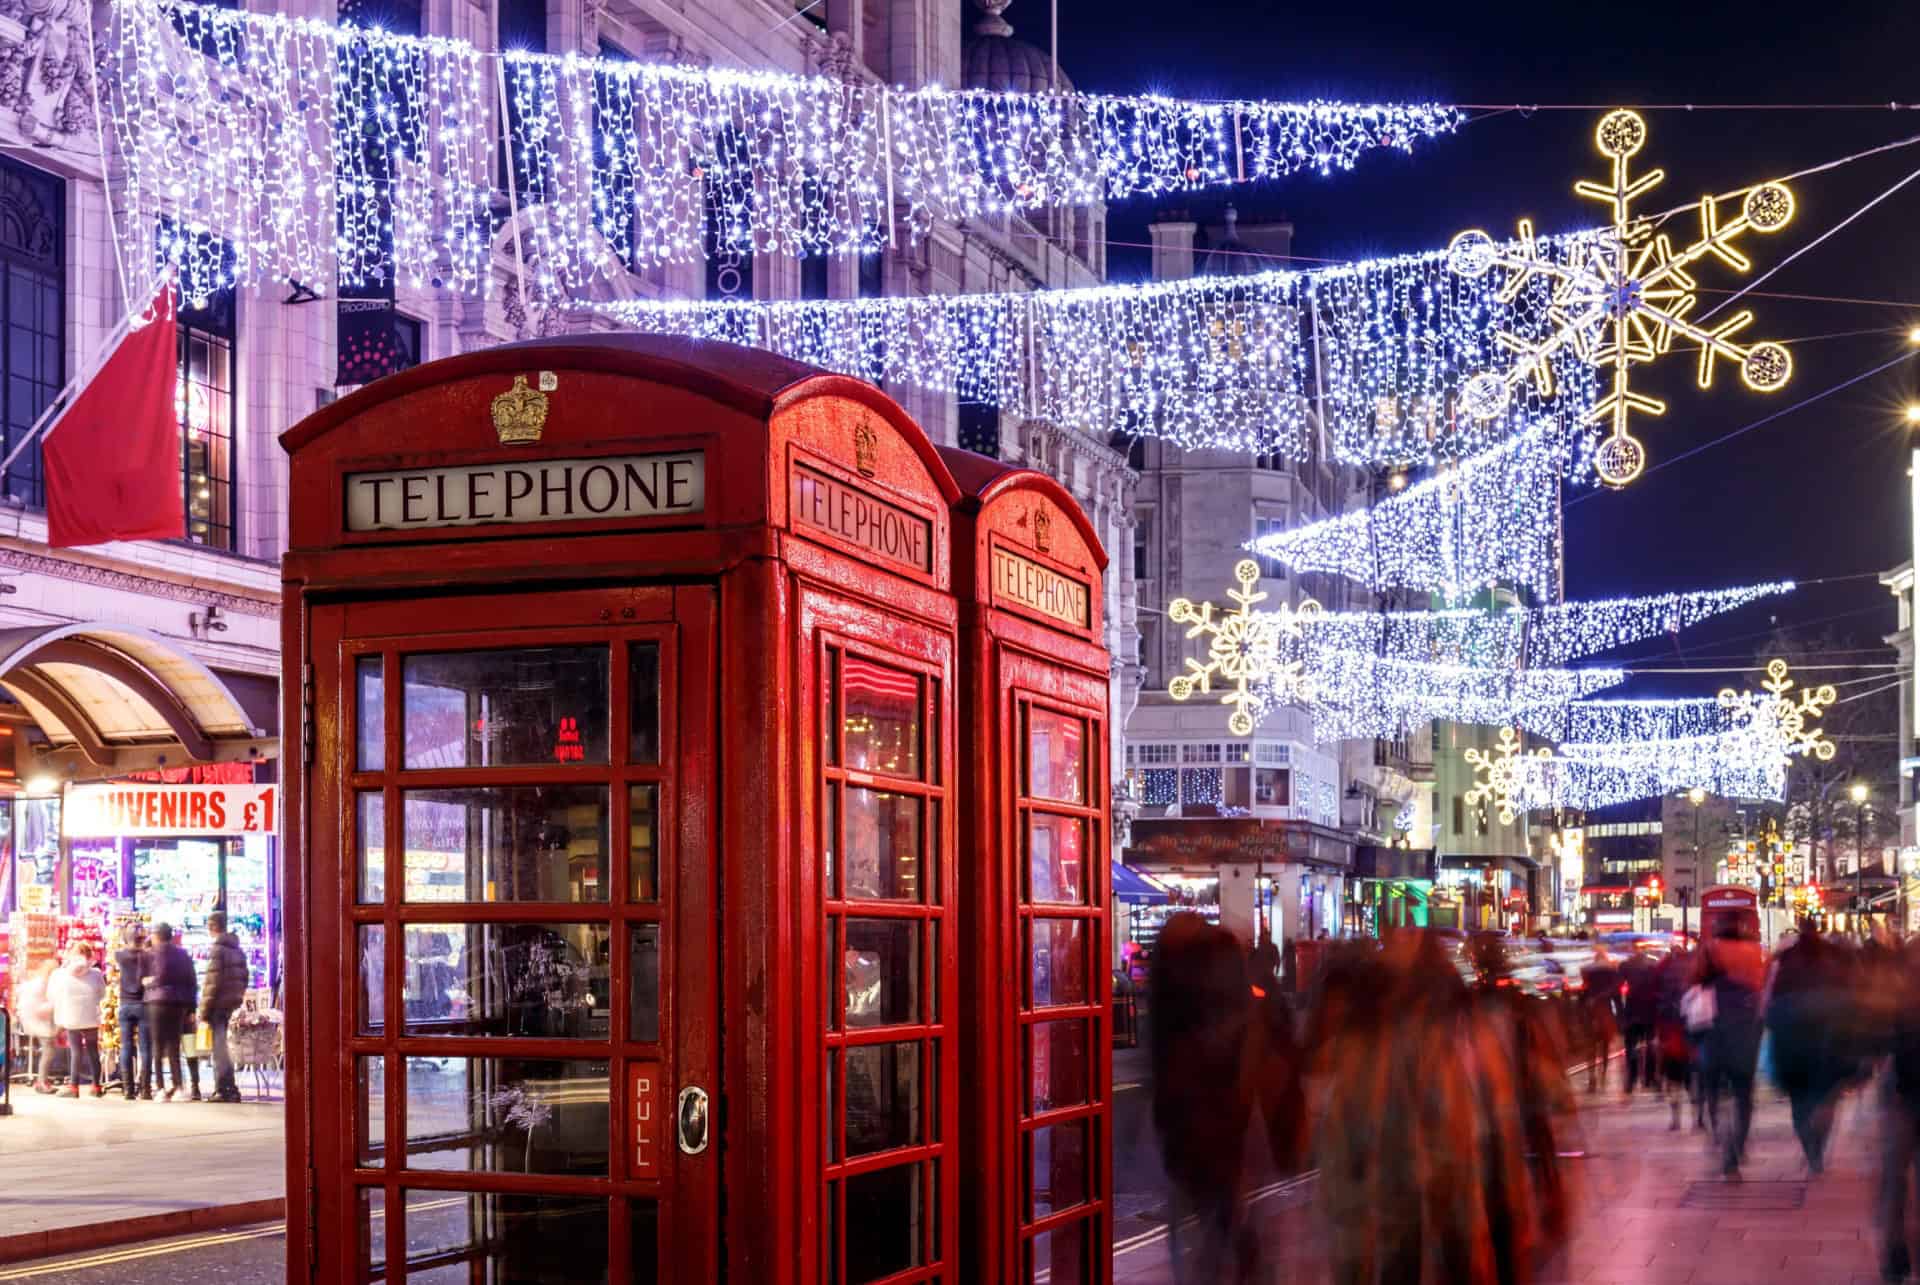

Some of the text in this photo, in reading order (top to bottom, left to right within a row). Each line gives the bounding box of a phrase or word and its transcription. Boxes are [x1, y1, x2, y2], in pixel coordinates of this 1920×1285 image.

[359, 459, 693, 524] TELEPHONE
[795, 473, 922, 566] TELEPHONE
[994, 552, 1084, 624] TELEPHONE
[97, 787, 274, 832] UVENIRS £1
[637, 1078, 650, 1166] PULL
